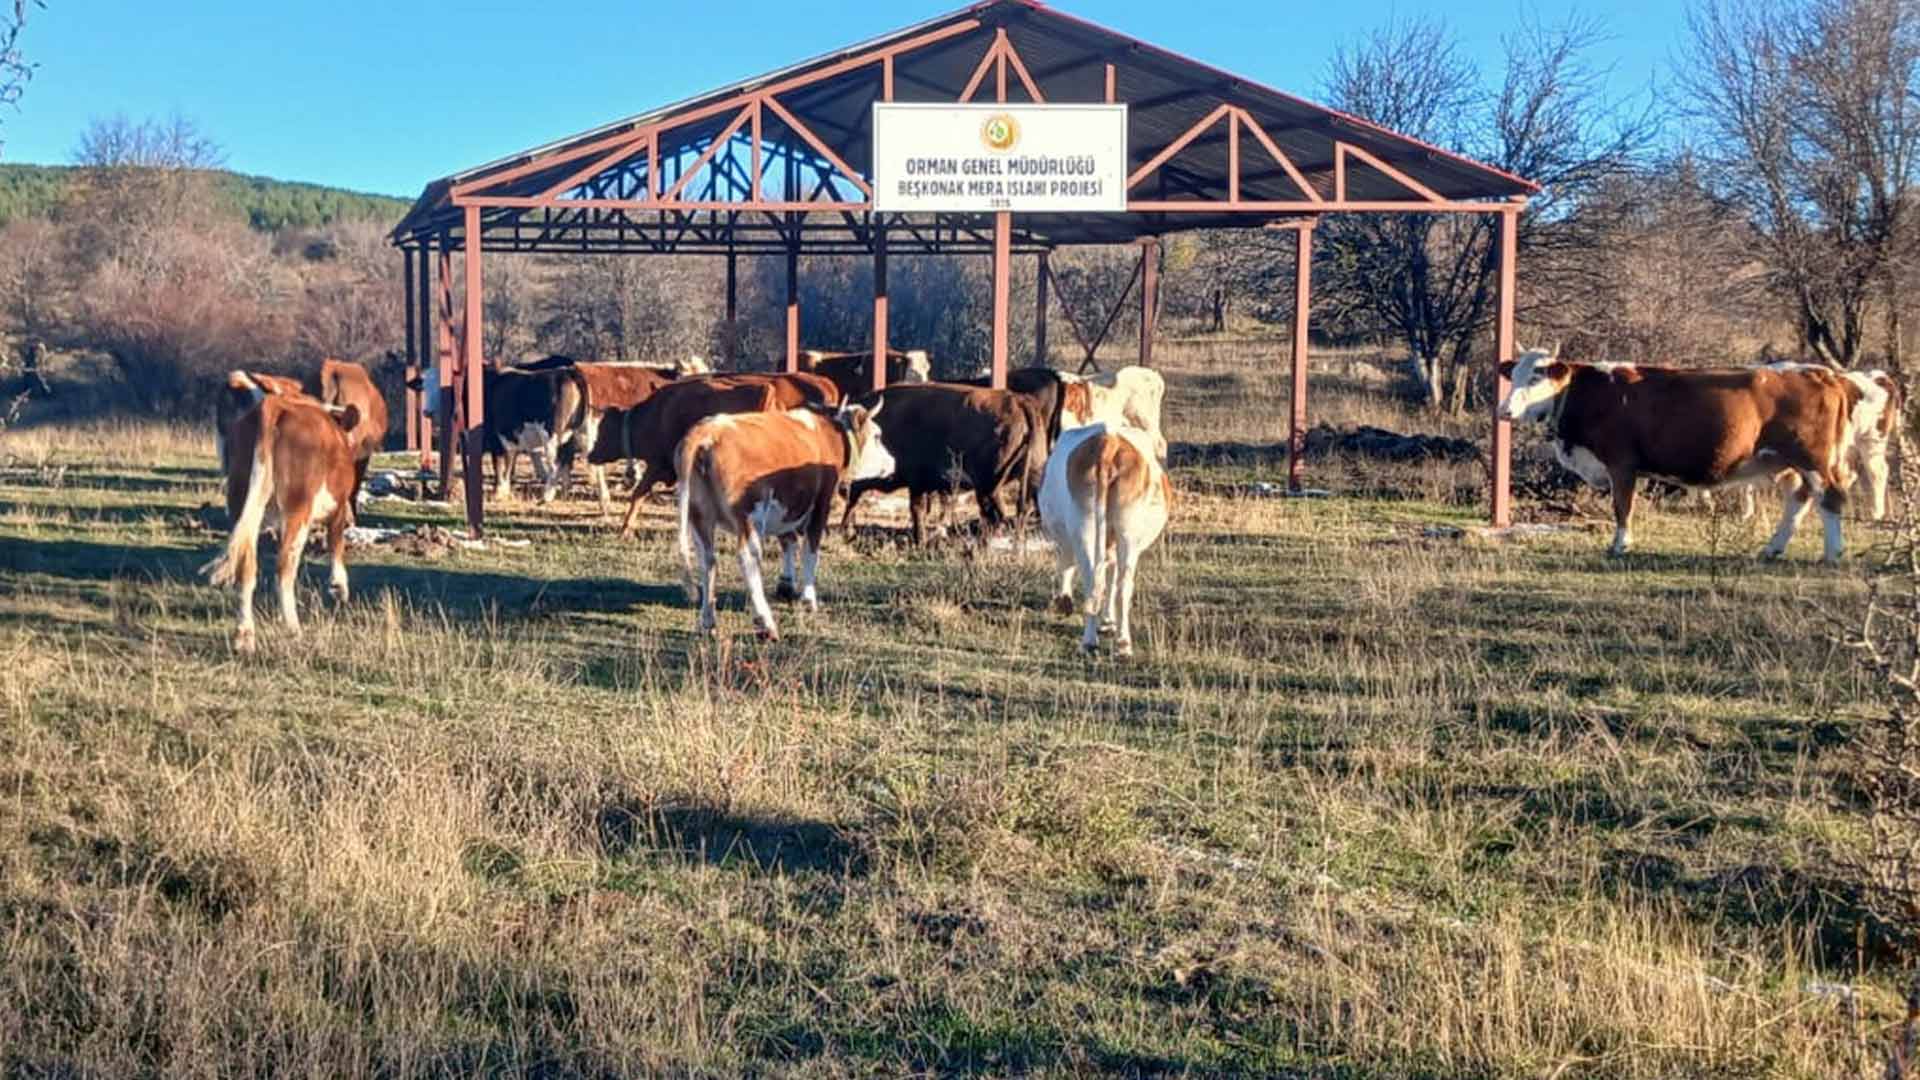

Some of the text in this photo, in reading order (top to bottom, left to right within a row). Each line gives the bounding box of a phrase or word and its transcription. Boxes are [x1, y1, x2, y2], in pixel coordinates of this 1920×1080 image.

[906, 155, 1095, 175] ORMAN GENEL MÜDÜRLÜĞÜ
[898, 178, 1103, 198] BEŞKONAK MERA ISLAHI PROJESİ
